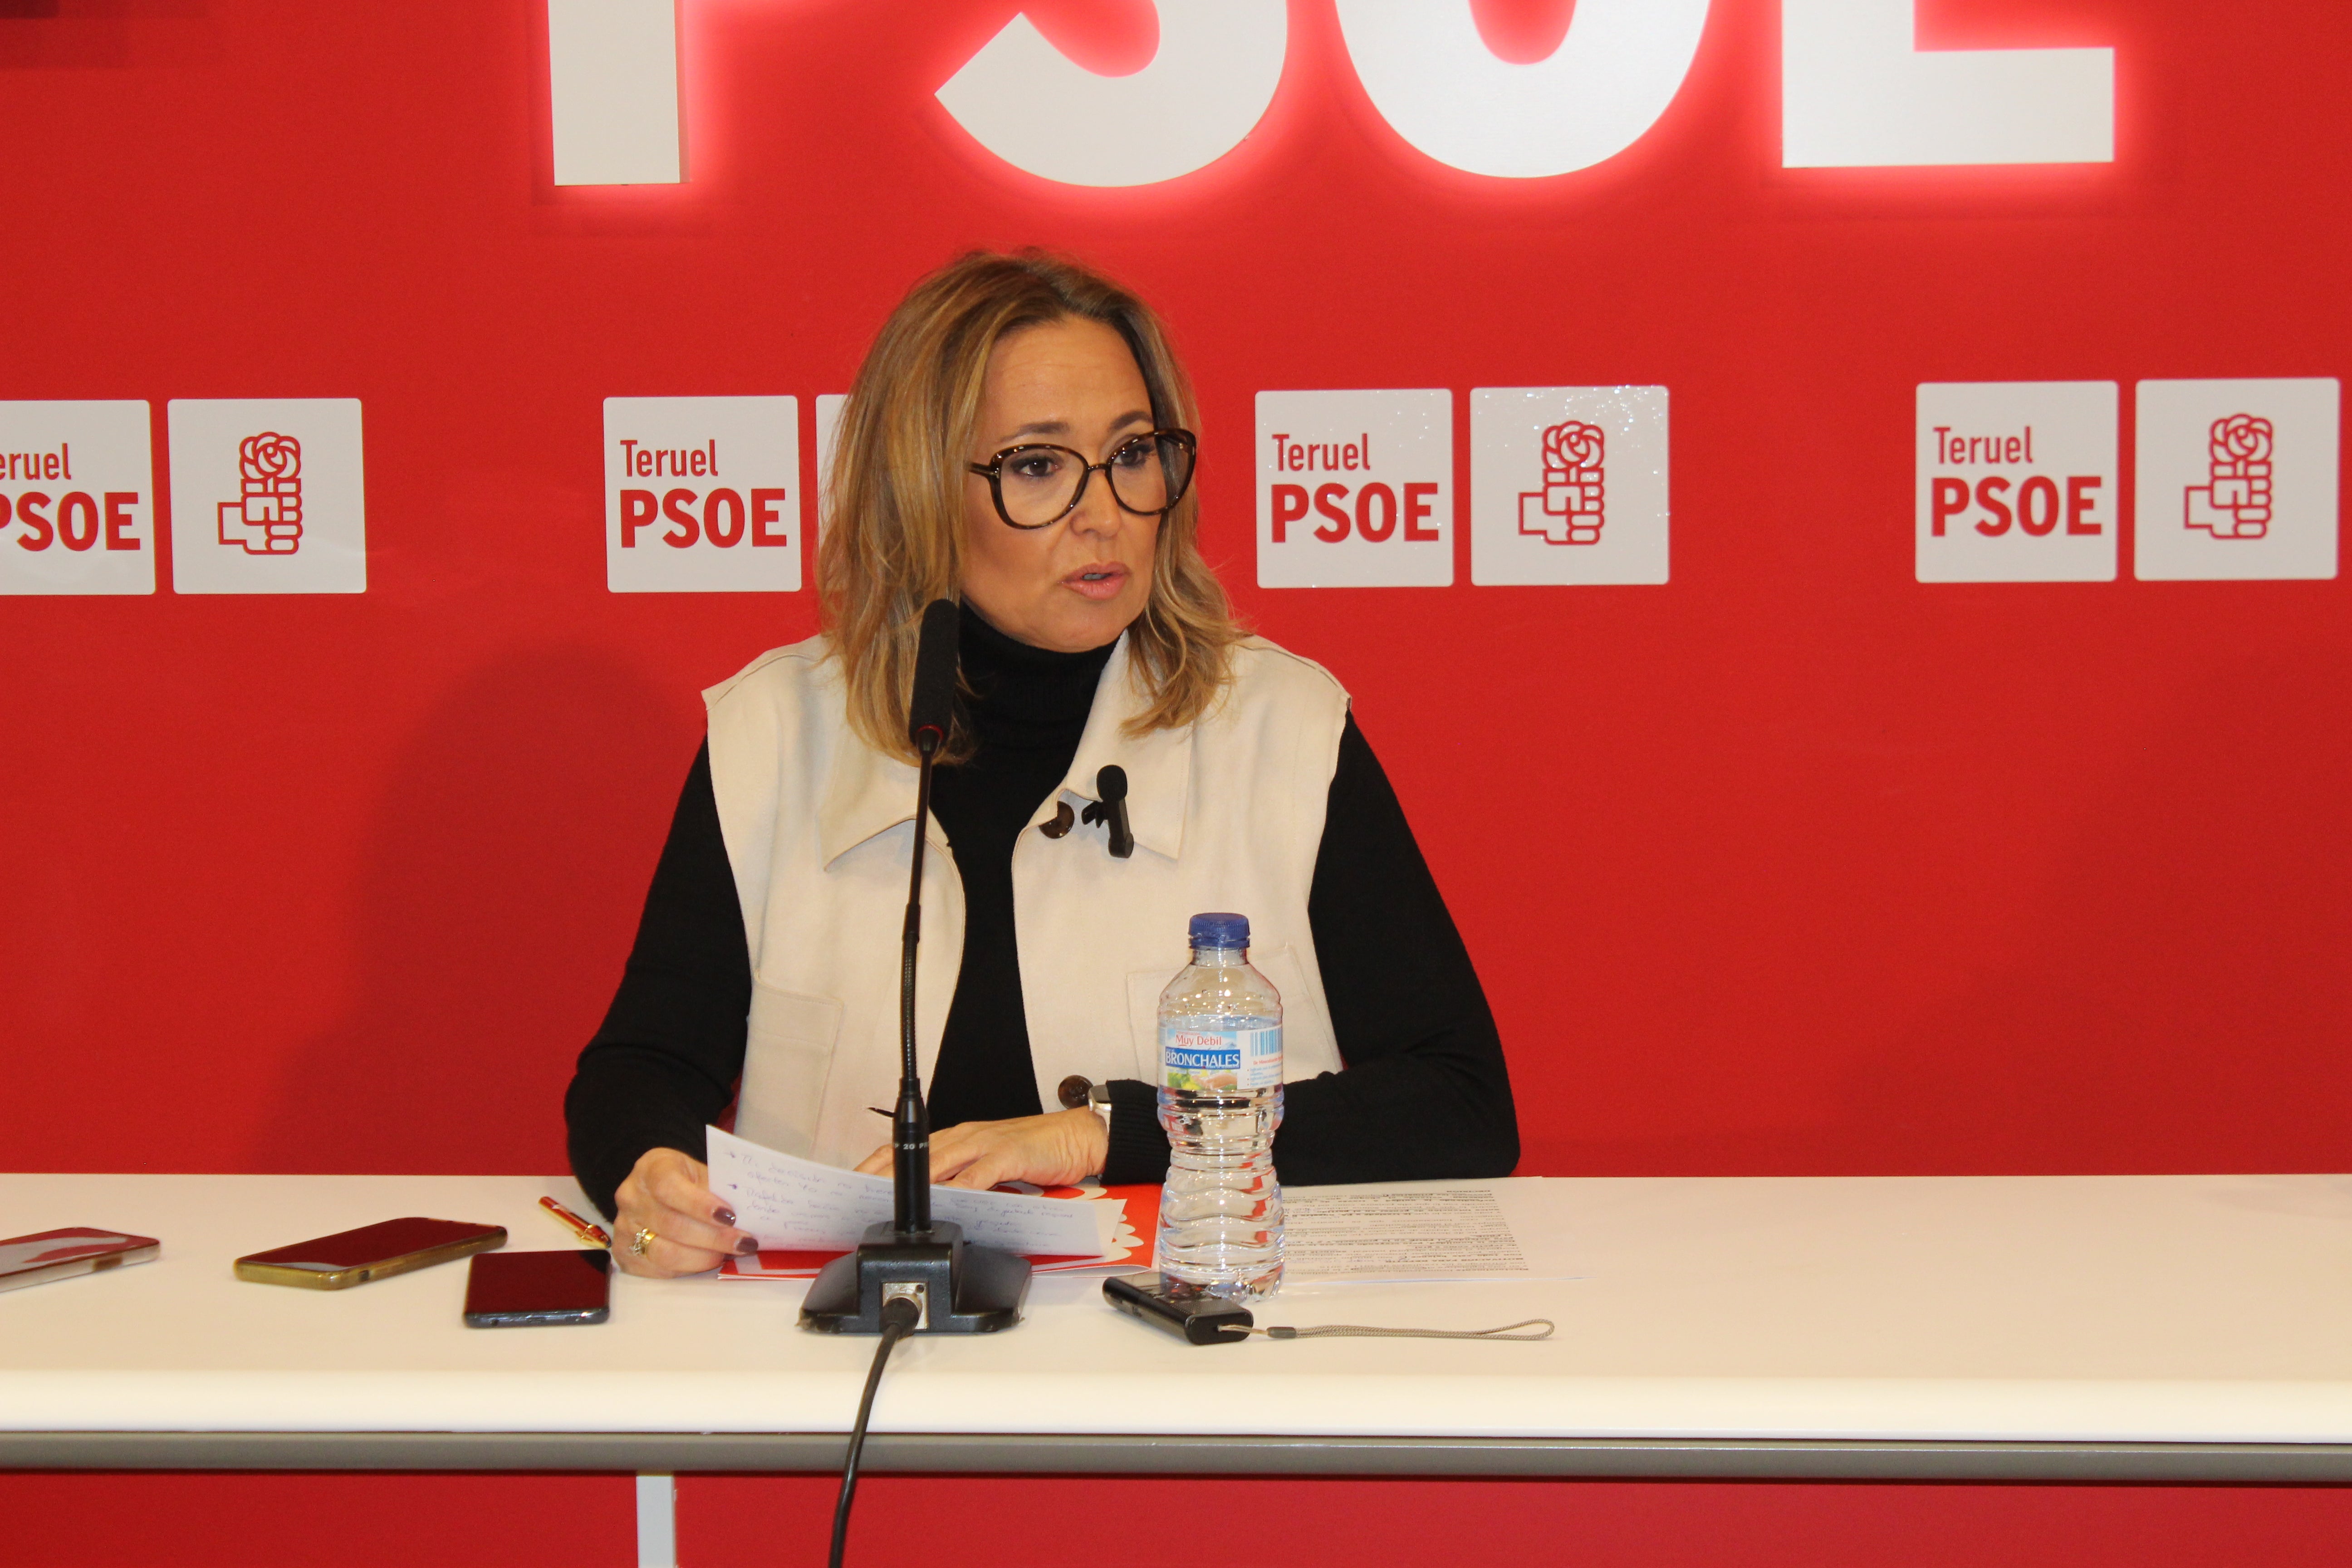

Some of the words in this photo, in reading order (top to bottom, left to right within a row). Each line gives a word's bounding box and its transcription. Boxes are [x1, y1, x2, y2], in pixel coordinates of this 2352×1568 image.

[620, 439, 718, 477] Teruel
[1272, 433, 1370, 471] Teruel
[1934, 426, 2033, 464] Teruel
[620, 488, 787, 549] PSOE
[1272, 482, 1439, 544] PSOE
[1932, 476, 2102, 537] PSOE
[1166, 1051, 1240, 1067] BRONCHALES
[1176, 1034, 1194, 1047] Muy
[1197, 1036, 1222, 1046] Débil
